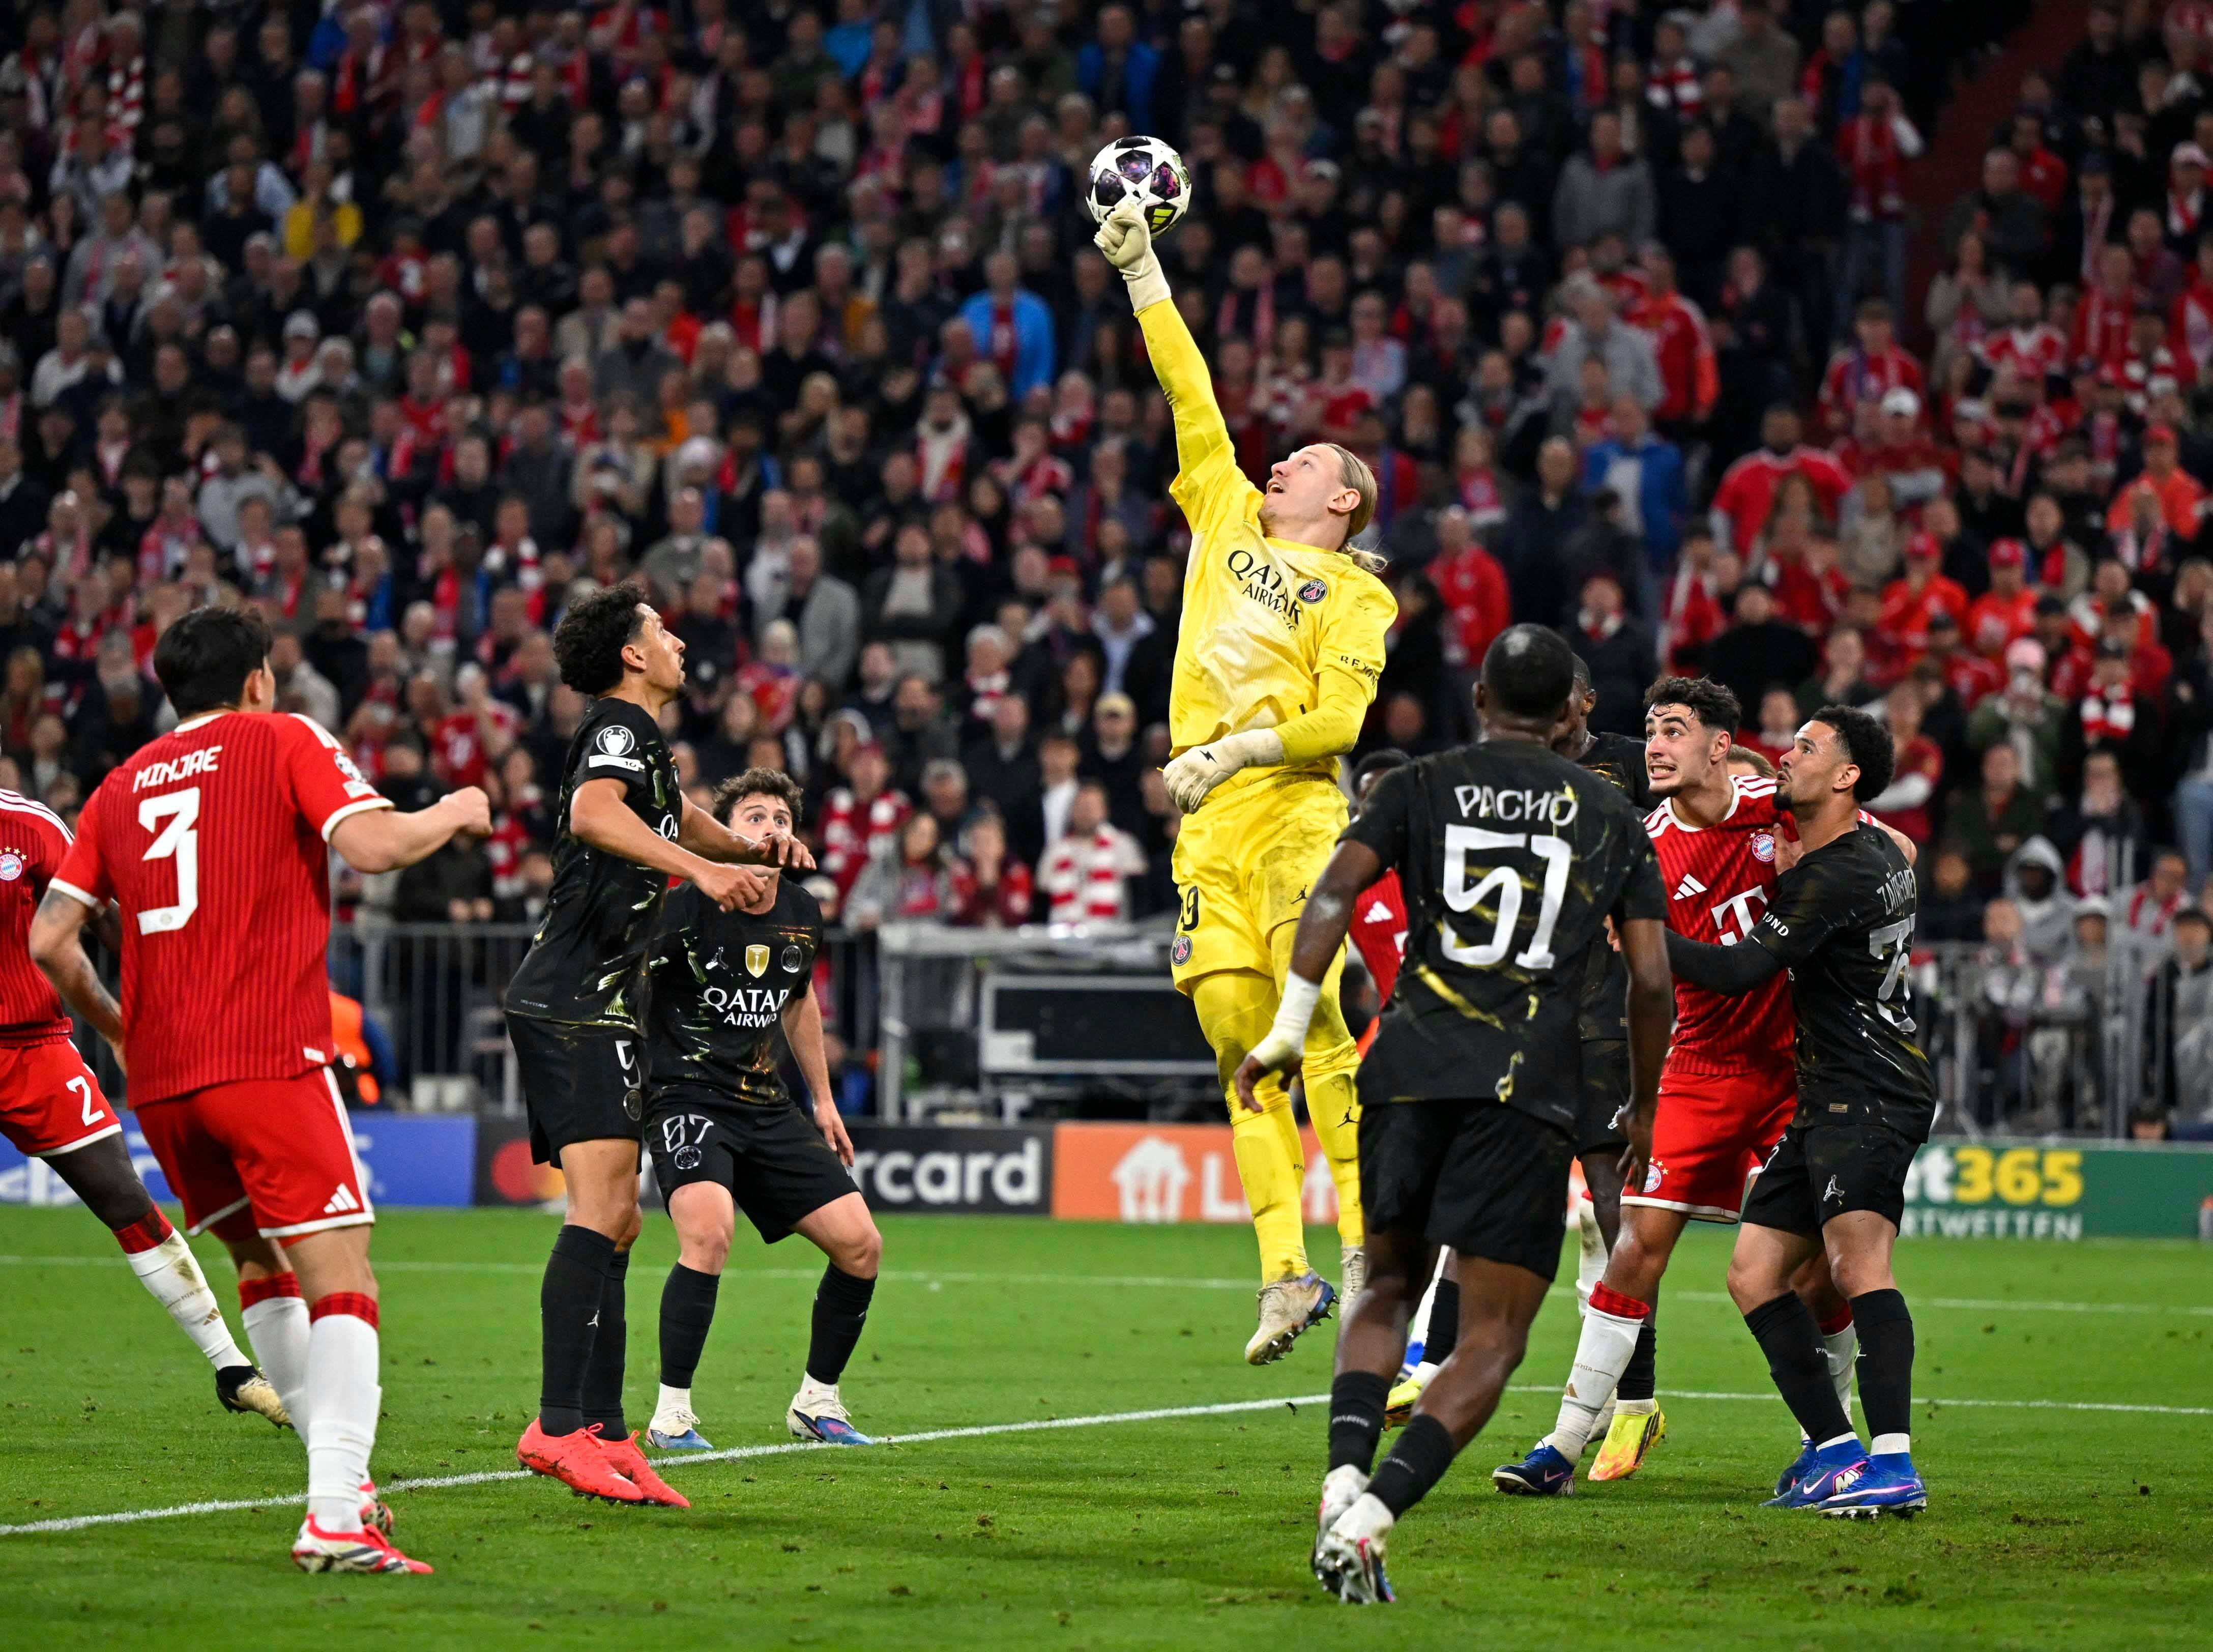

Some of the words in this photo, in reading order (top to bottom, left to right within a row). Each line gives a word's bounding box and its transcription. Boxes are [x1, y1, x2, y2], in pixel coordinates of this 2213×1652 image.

[1310, 581, 1325, 592] PARIS
[133, 745, 223, 794] MINJAE
[1454, 785, 1578, 827] PACHO
[137, 787, 200, 935] 3
[1181, 886, 1199, 931] 9
[1441, 823, 1572, 969] 51
[1763, 911, 1789, 936] YOND
[65, 1075, 105, 1126] 2
[663, 1114, 714, 1153] 87
[853, 1137, 1043, 1205] rcard
